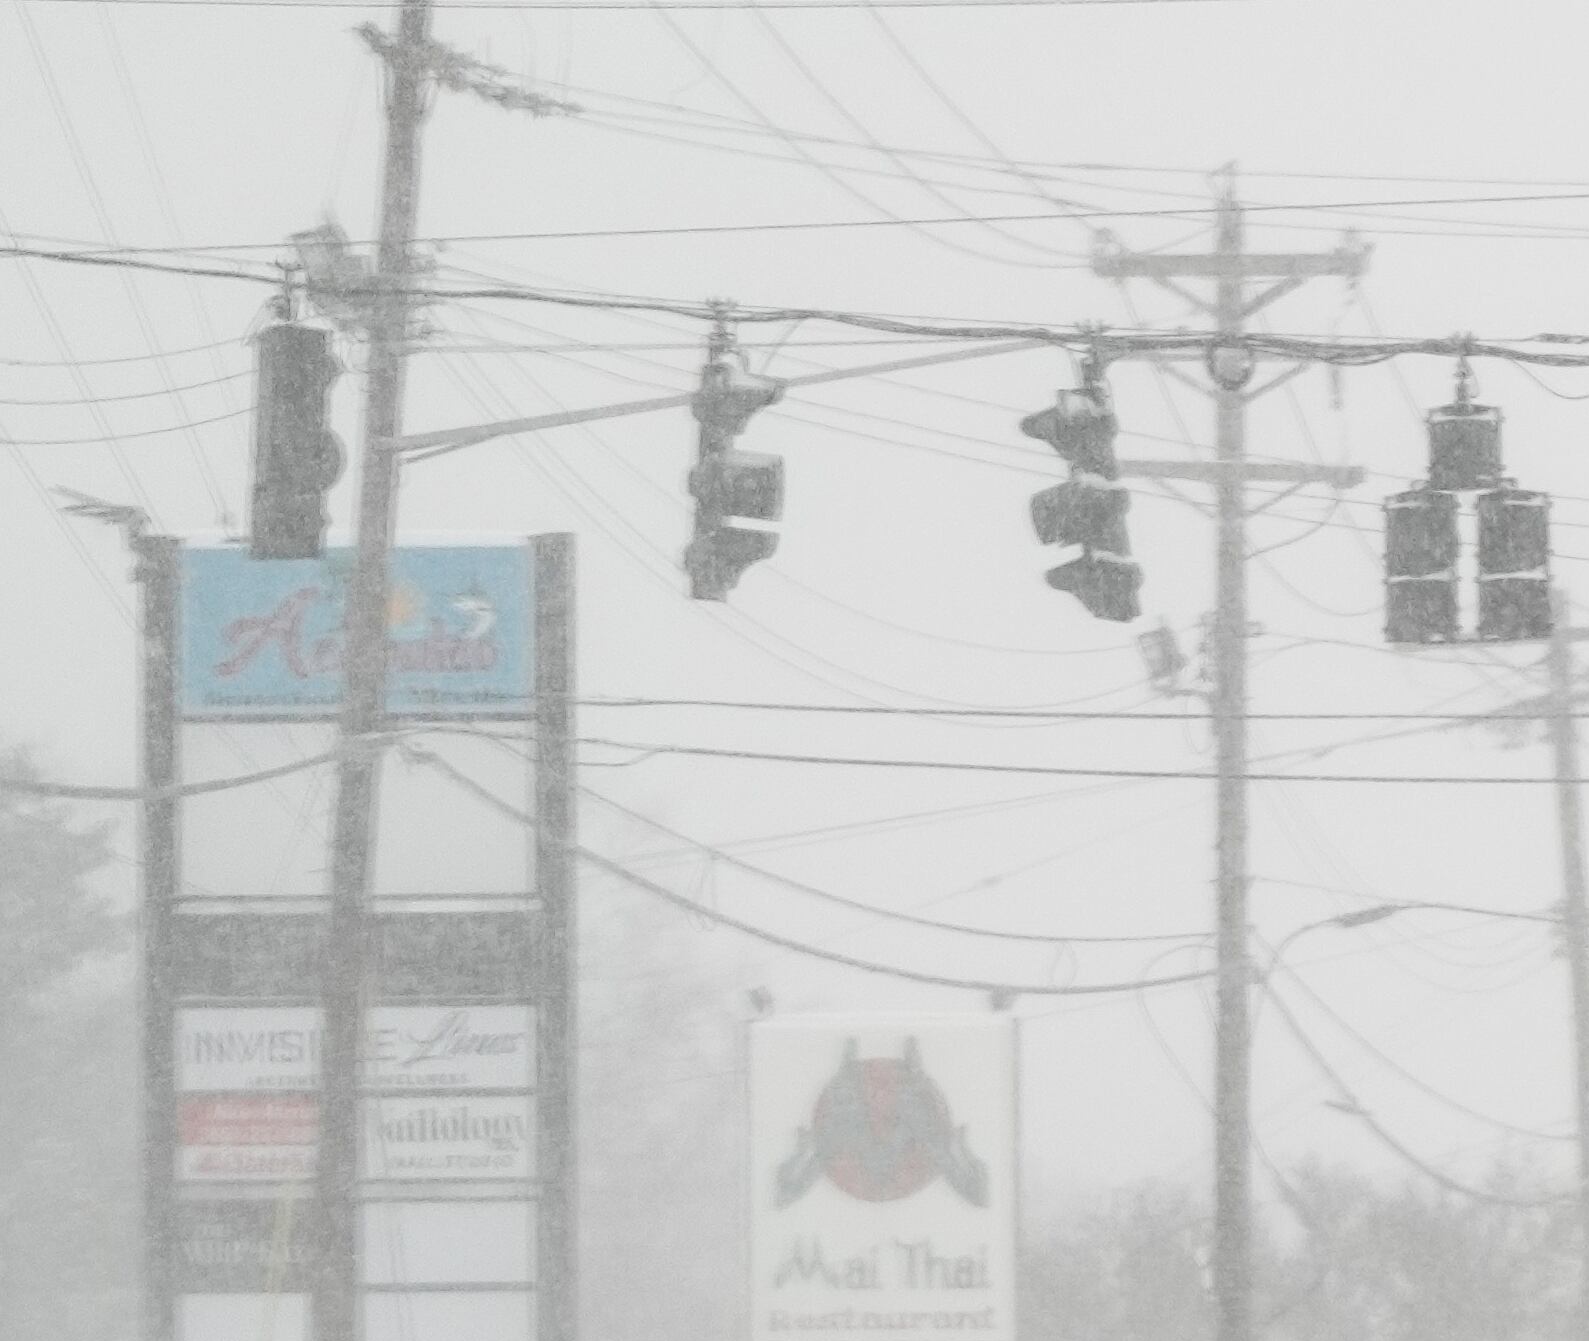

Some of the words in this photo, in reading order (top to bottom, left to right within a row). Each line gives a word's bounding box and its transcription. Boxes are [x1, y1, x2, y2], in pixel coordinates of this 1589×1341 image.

[773, 1233, 880, 1290] Mai
[890, 1235, 993, 1290] Thai
[769, 1306, 996, 1332] Restaurant
